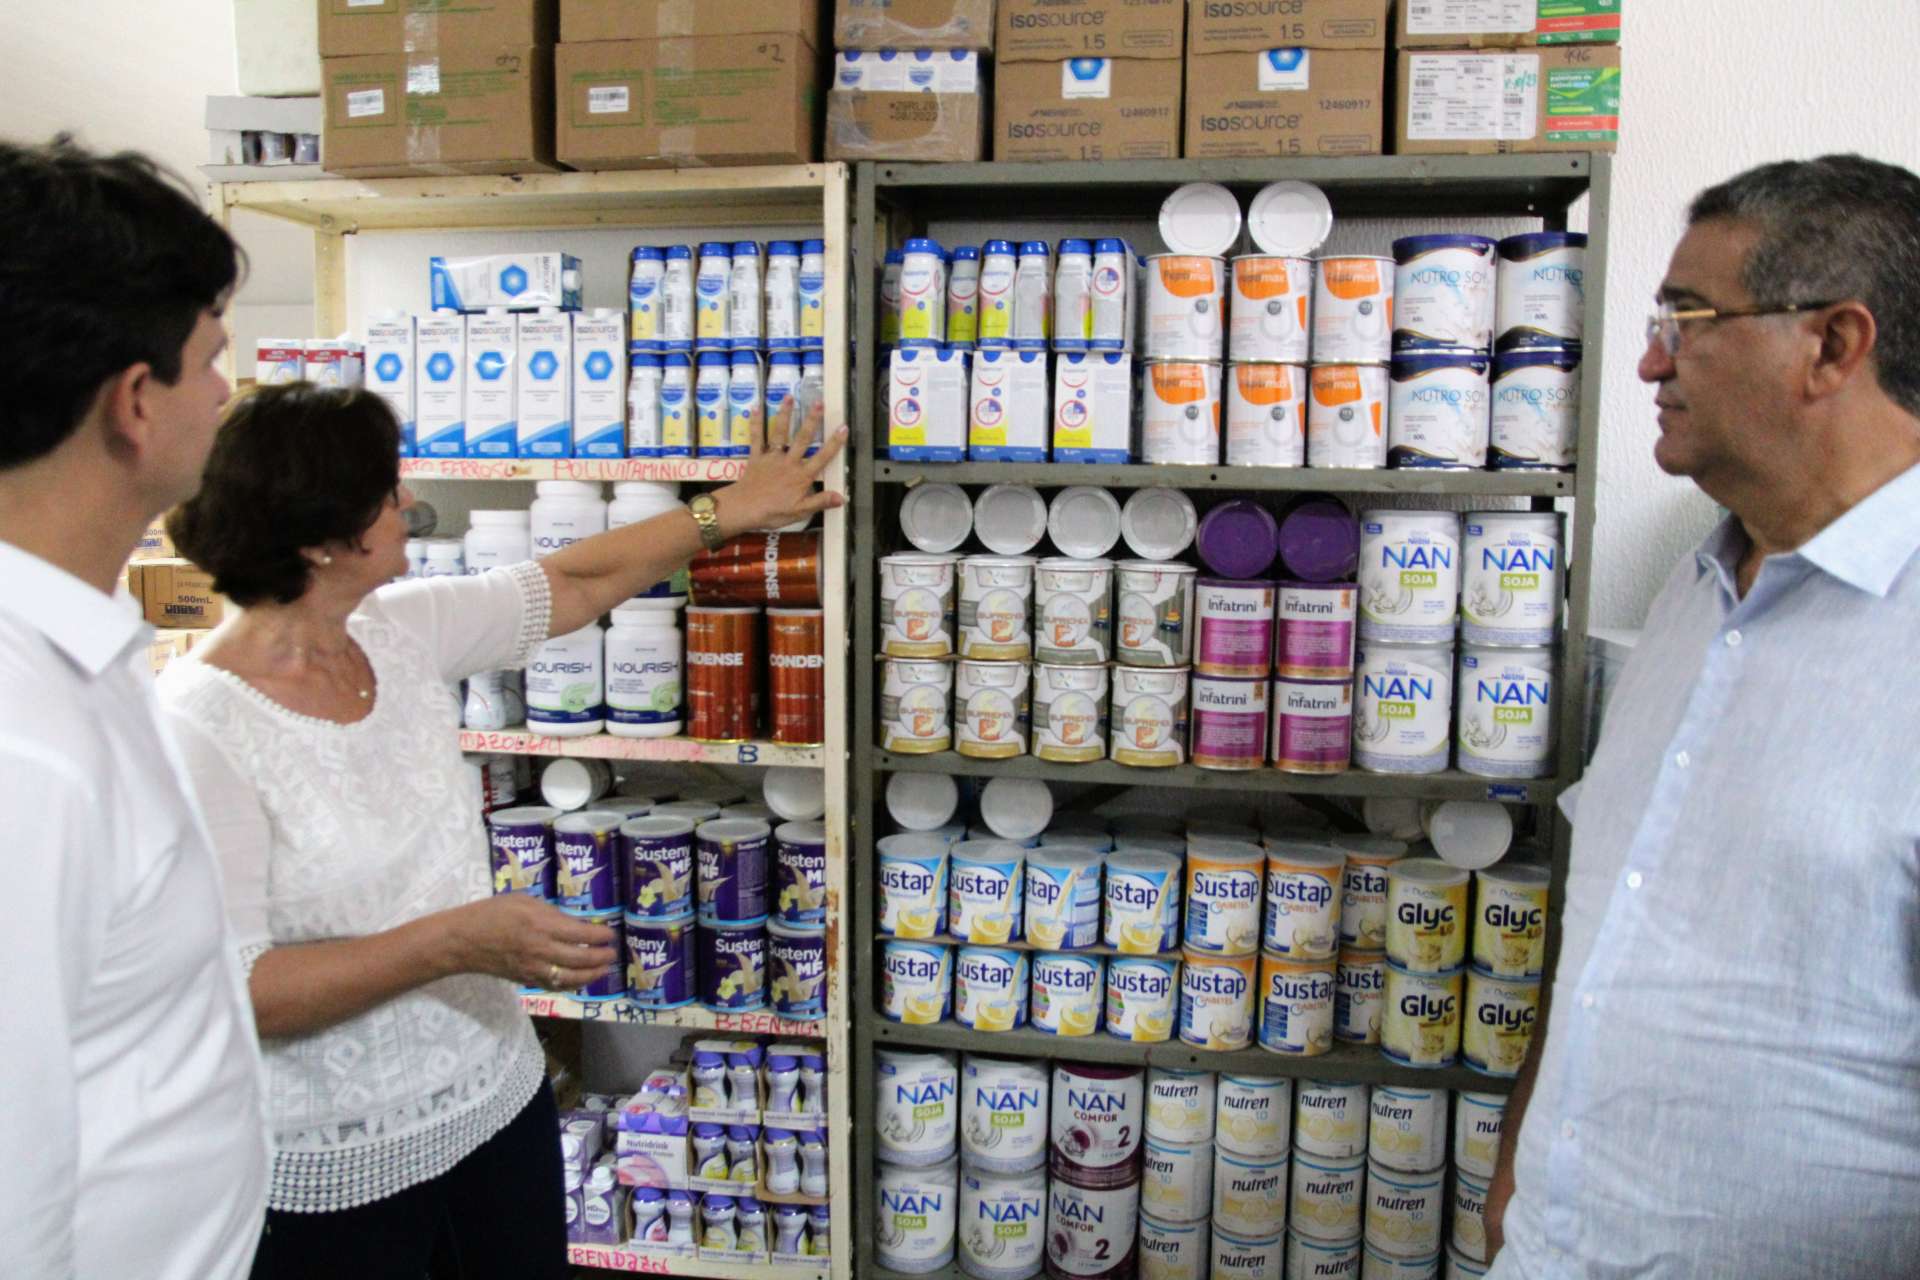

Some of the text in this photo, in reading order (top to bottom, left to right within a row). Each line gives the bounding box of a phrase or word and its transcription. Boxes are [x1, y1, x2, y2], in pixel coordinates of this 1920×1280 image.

[1011, 10, 1105, 29] isosource
[1008, 120, 1101, 138] isosource
[1201, 114, 1300, 131] isosource
[1382, 546, 1450, 569] NAN
[1483, 548, 1553, 570] NAN
[1403, 574, 1433, 584] SOJA
[1504, 576, 1536, 587] SOJA
[1208, 599, 1257, 613] Infatrini
[1286, 600, 1333, 614] Infatrini
[613, 661, 679, 673] NOURISH
[1364, 675, 1433, 700] NAN
[1478, 680, 1548, 704] NAN
[1200, 692, 1247, 706] Infatrini
[1288, 695, 1337, 709] Infatrini
[1381, 704, 1412, 715] SOJA
[1497, 710, 1528, 720] SOJA
[518, 848, 545, 862] MF
[568, 857, 594, 871] MF
[1194, 871, 1259, 902] Sustap
[1398, 903, 1454, 930] Glyc
[1485, 904, 1541, 933] Glyc
[640, 952, 667, 966] MF
[796, 962, 823, 976] MF
[1033, 959, 1097, 992] Sustap
[1109, 967, 1171, 998] Sustap
[1183, 965, 1246, 999] Sustap
[1272, 975, 1335, 1002] Sustap
[1401, 994, 1455, 1021] Glyc
[1478, 1004, 1535, 1031] Glyc
[897, 1077, 954, 1104] NAN
[977, 1087, 1038, 1111] NAN
[1154, 1084, 1198, 1097] nutren
[1068, 1088, 1125, 1112] NAN
[1224, 1095, 1269, 1109] nutren
[1302, 1093, 1346, 1108] nutren
[1074, 1110, 1118, 1121] COMFOR
[1372, 1102, 1413, 1120] nutren
[1118, 1125, 1130, 1148] 2
[1232, 1176, 1278, 1191] nutren
[1306, 1179, 1353, 1194] nutren
[881, 1188, 941, 1214] NAN
[1053, 1192, 1103, 1223] NAN
[1377, 1195, 1424, 1211] nutren
[979, 1199, 1040, 1222] NAN
[1056, 1215, 1094, 1232] COMFOR
[1095, 1238, 1109, 1260] 2
[1220, 1253, 1265, 1268] nutren
